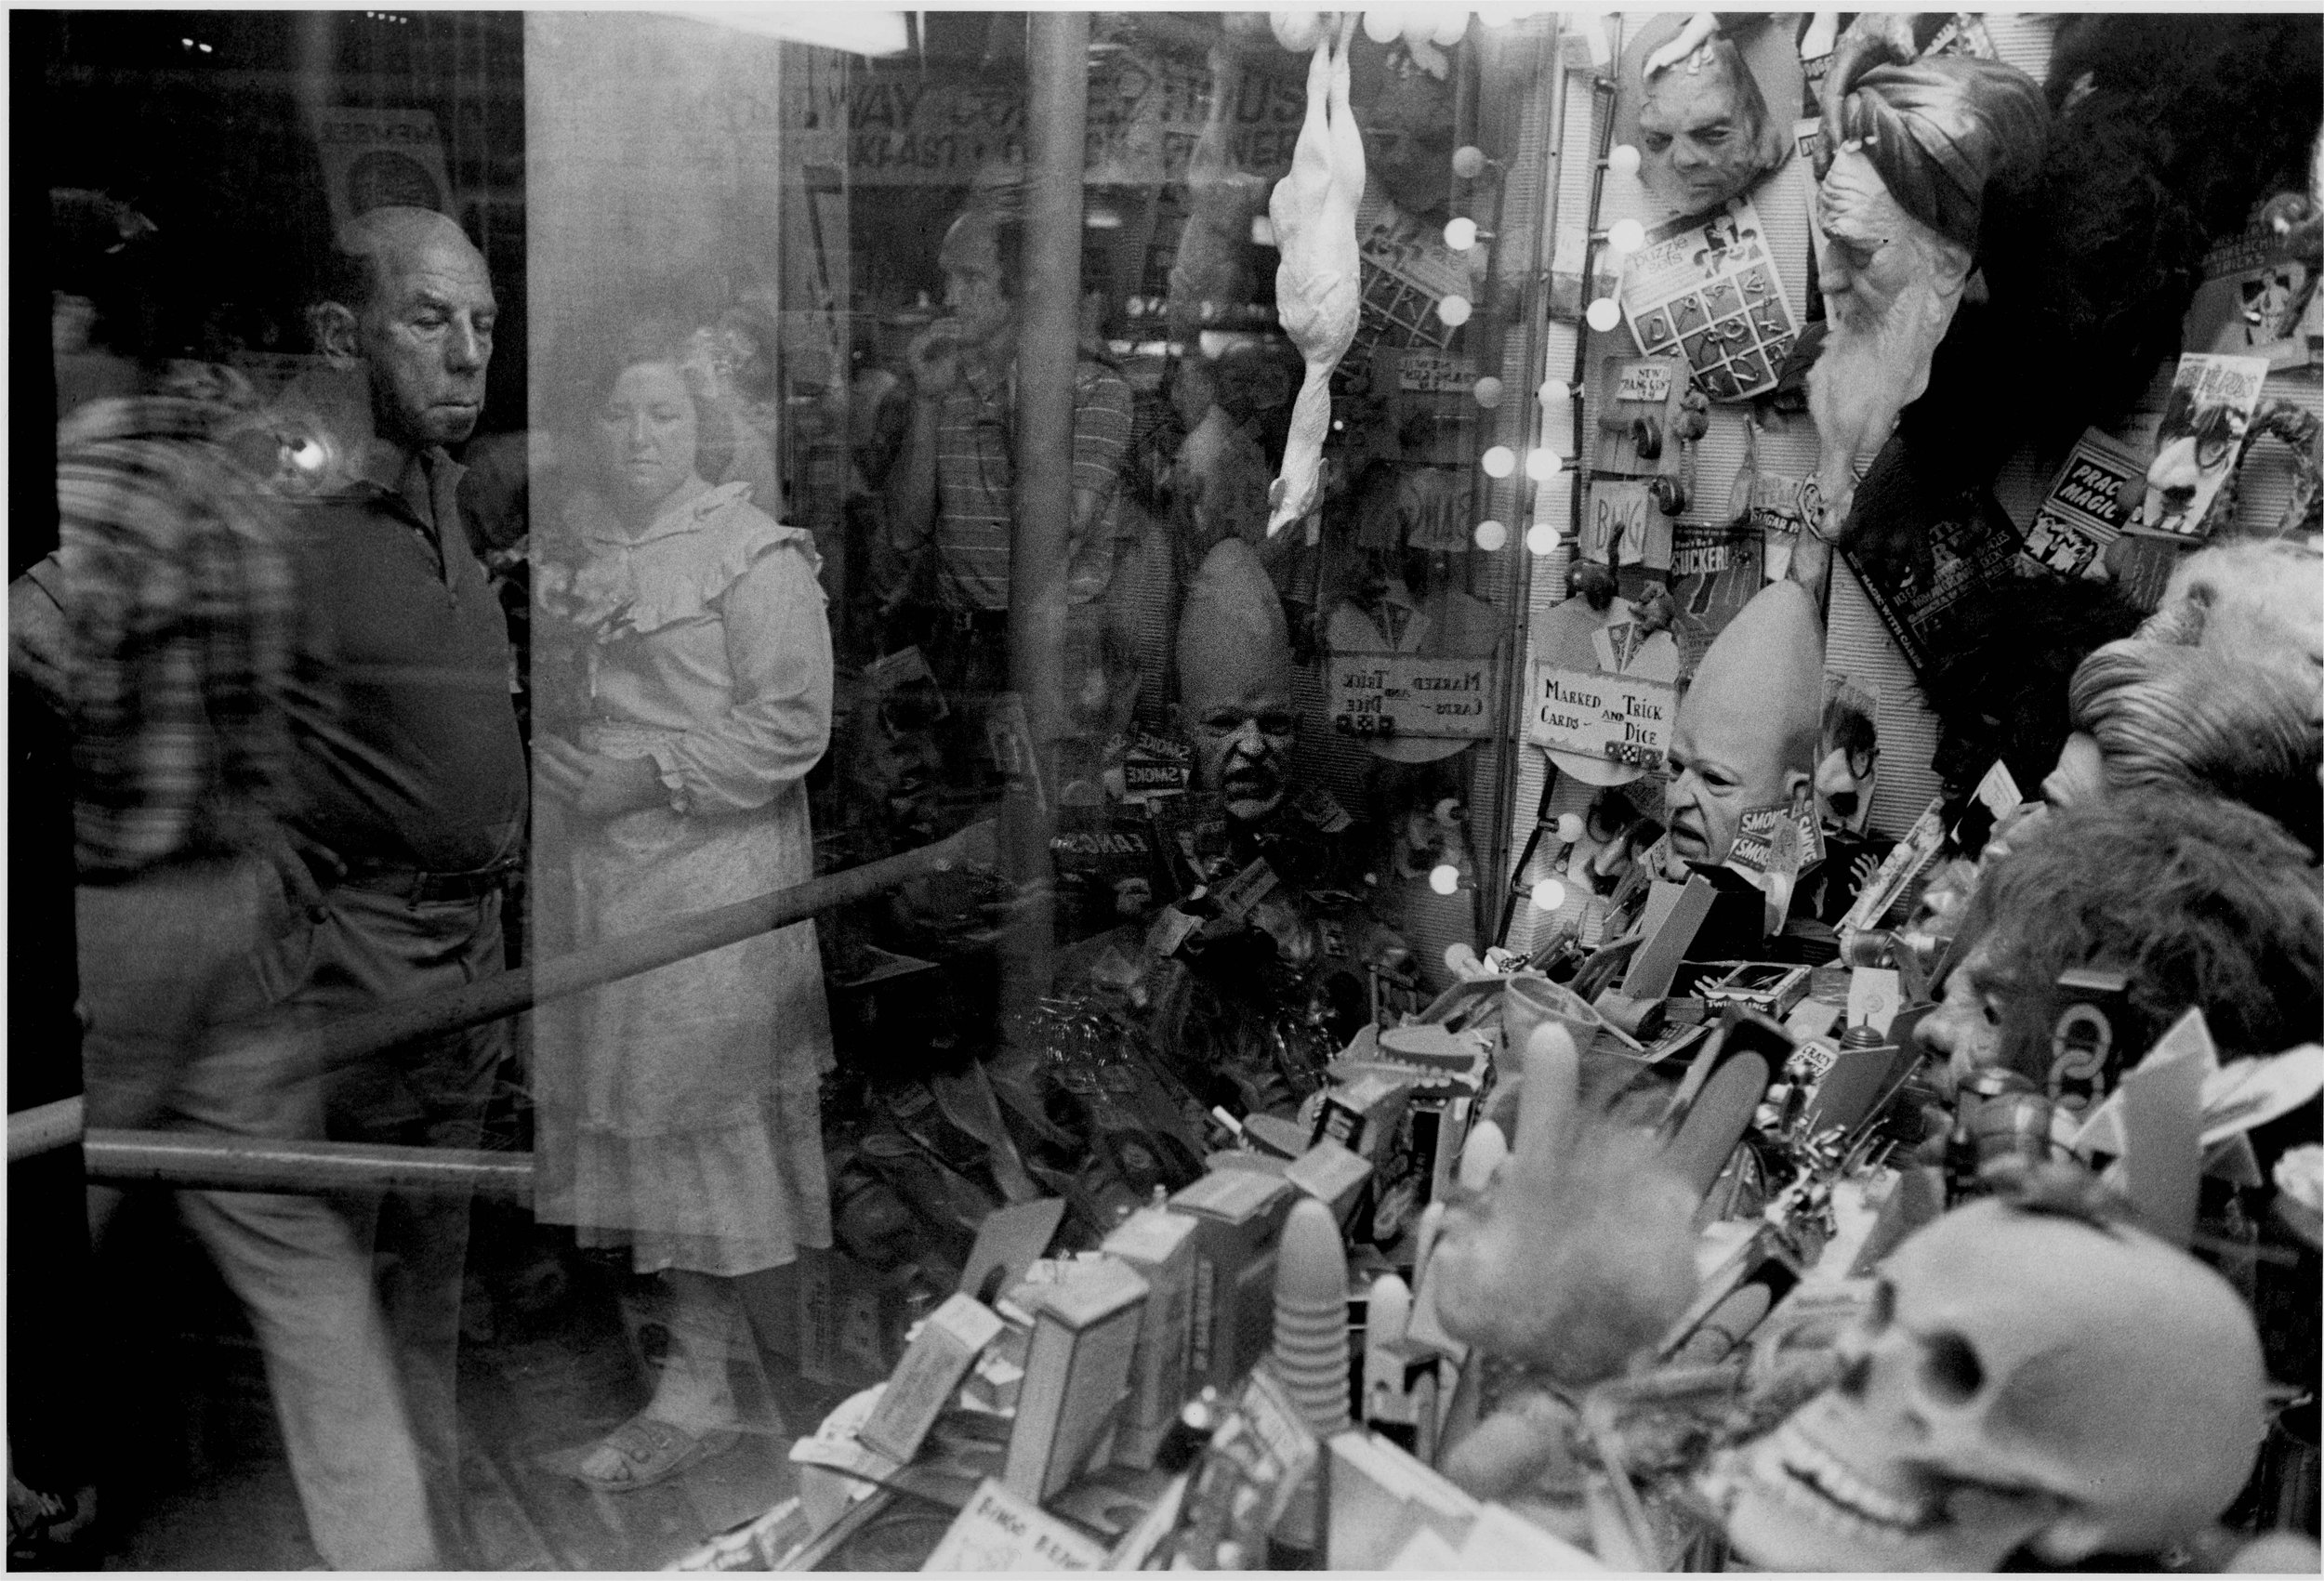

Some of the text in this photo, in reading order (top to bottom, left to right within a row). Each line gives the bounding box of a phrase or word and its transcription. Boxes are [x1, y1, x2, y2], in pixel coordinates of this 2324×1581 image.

[851, 133, 956, 168] KFAST
[1631, 235, 1689, 268] puzzle
[2071, 464, 2124, 496] PRAC
[2058, 482, 2119, 520] MAGIC
[1751, 511, 1788, 531] SUGAR
[1672, 545, 1730, 575] SUCKER!
[1861, 573, 1885, 606] MAGIC
[1545, 679, 1663, 721] MARKED AND TRICK
[1540, 705, 1658, 745] CARDS DICE
[1707, 999, 1769, 1013] TWILING
[1802, 1045, 1833, 1068] CRAZY
